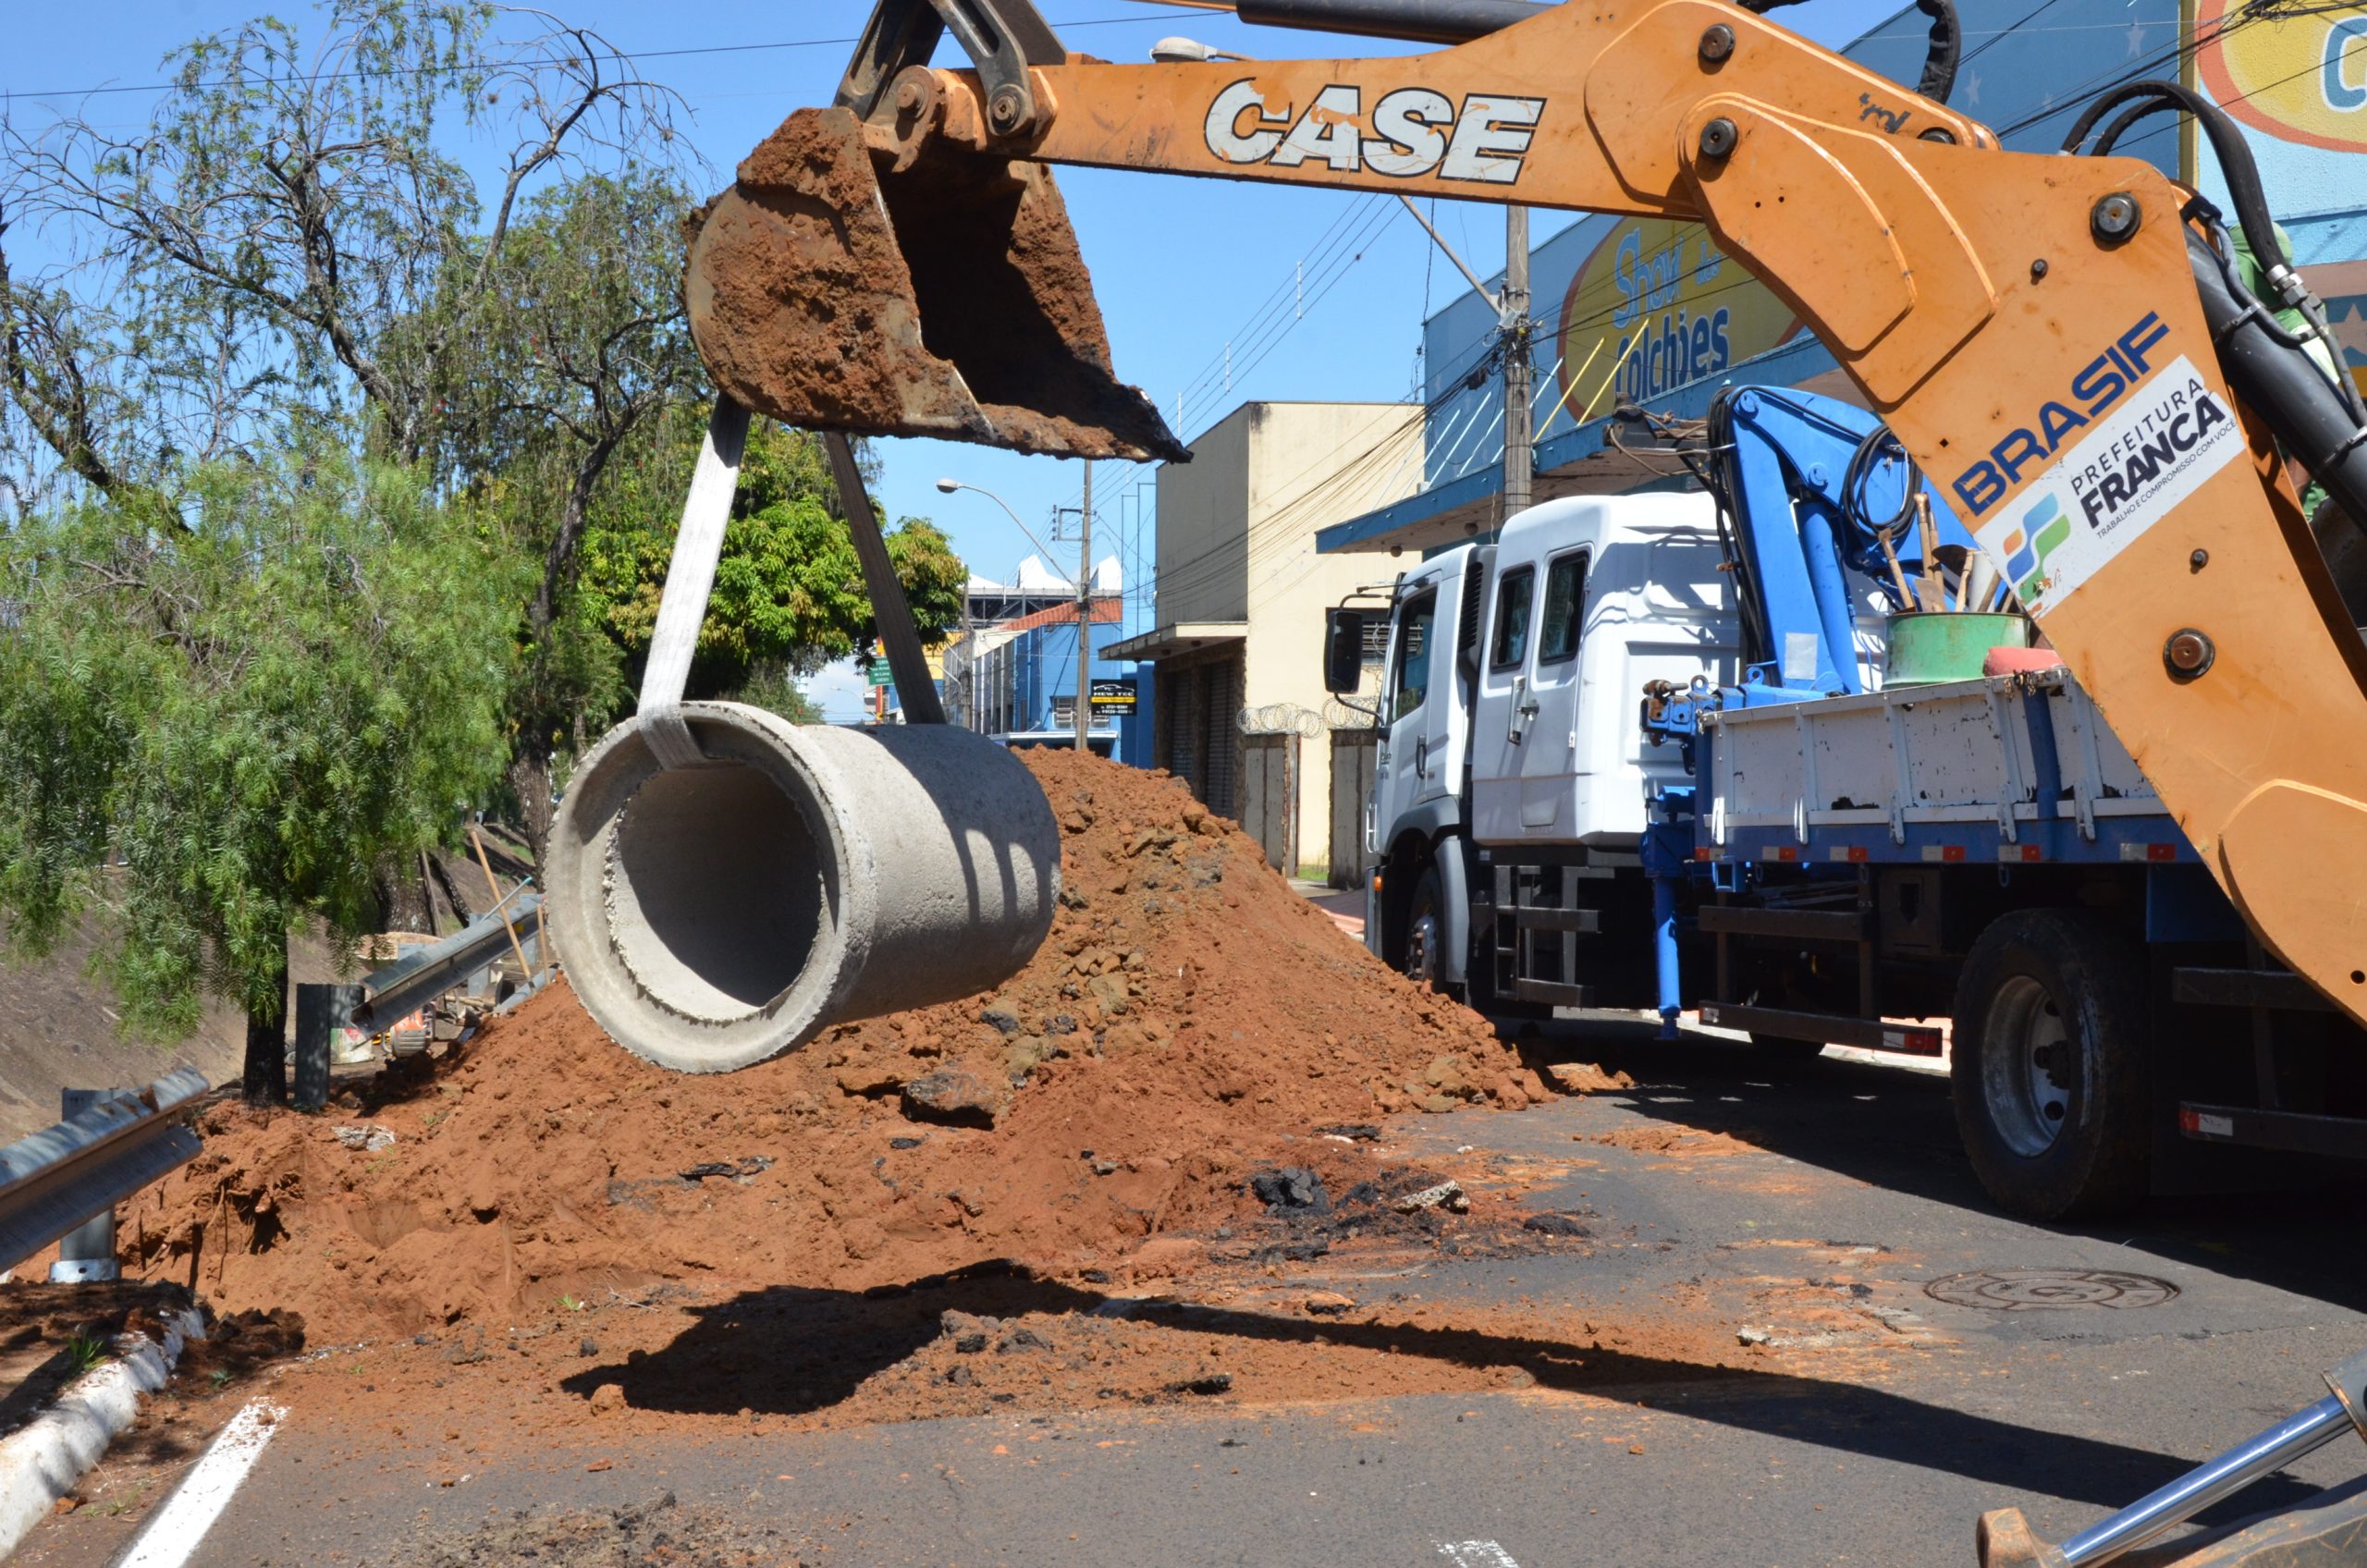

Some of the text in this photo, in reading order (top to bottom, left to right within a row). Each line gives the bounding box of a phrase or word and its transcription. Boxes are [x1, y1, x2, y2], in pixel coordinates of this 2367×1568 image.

[1204, 77, 1548, 185] CASE
[1951, 310, 2170, 517] BRASIF
[2071, 377, 2203, 496] PREFEITURA
[2080, 394, 2226, 529] FRANCA
[2097, 504, 2136, 539] TRABALHO
[2135, 499, 2141, 508] E
[2140, 453, 2197, 503] COMPROMISSO
[2196, 438, 2215, 457] COM
